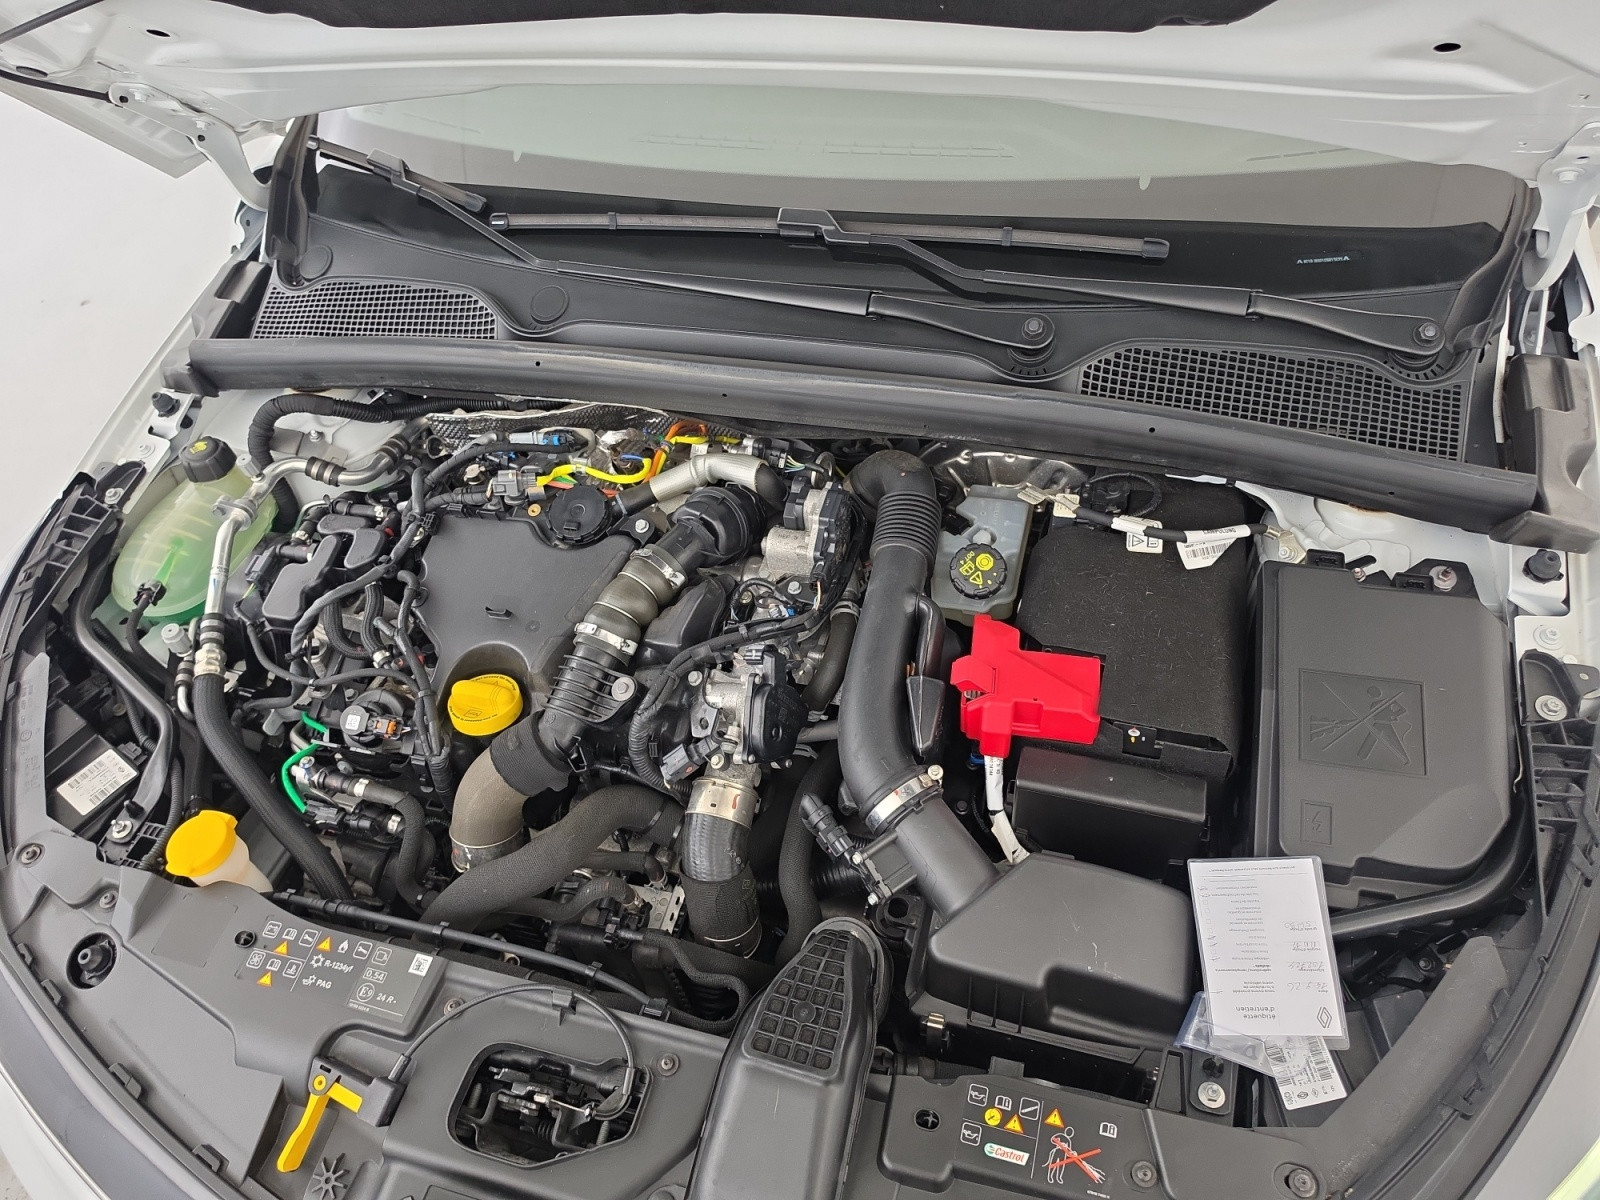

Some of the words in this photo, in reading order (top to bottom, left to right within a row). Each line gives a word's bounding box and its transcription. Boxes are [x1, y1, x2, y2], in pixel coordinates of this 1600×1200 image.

[964, 550, 976, 562] DOT
[324, 960, 354, 974] R-1234yf
[316, 978, 332, 989] PAG
[376, 992, 387, 1002] 24
[1243, 1012, 1276, 1021] étiquette
[994, 1147, 1026, 1163] Castrol
